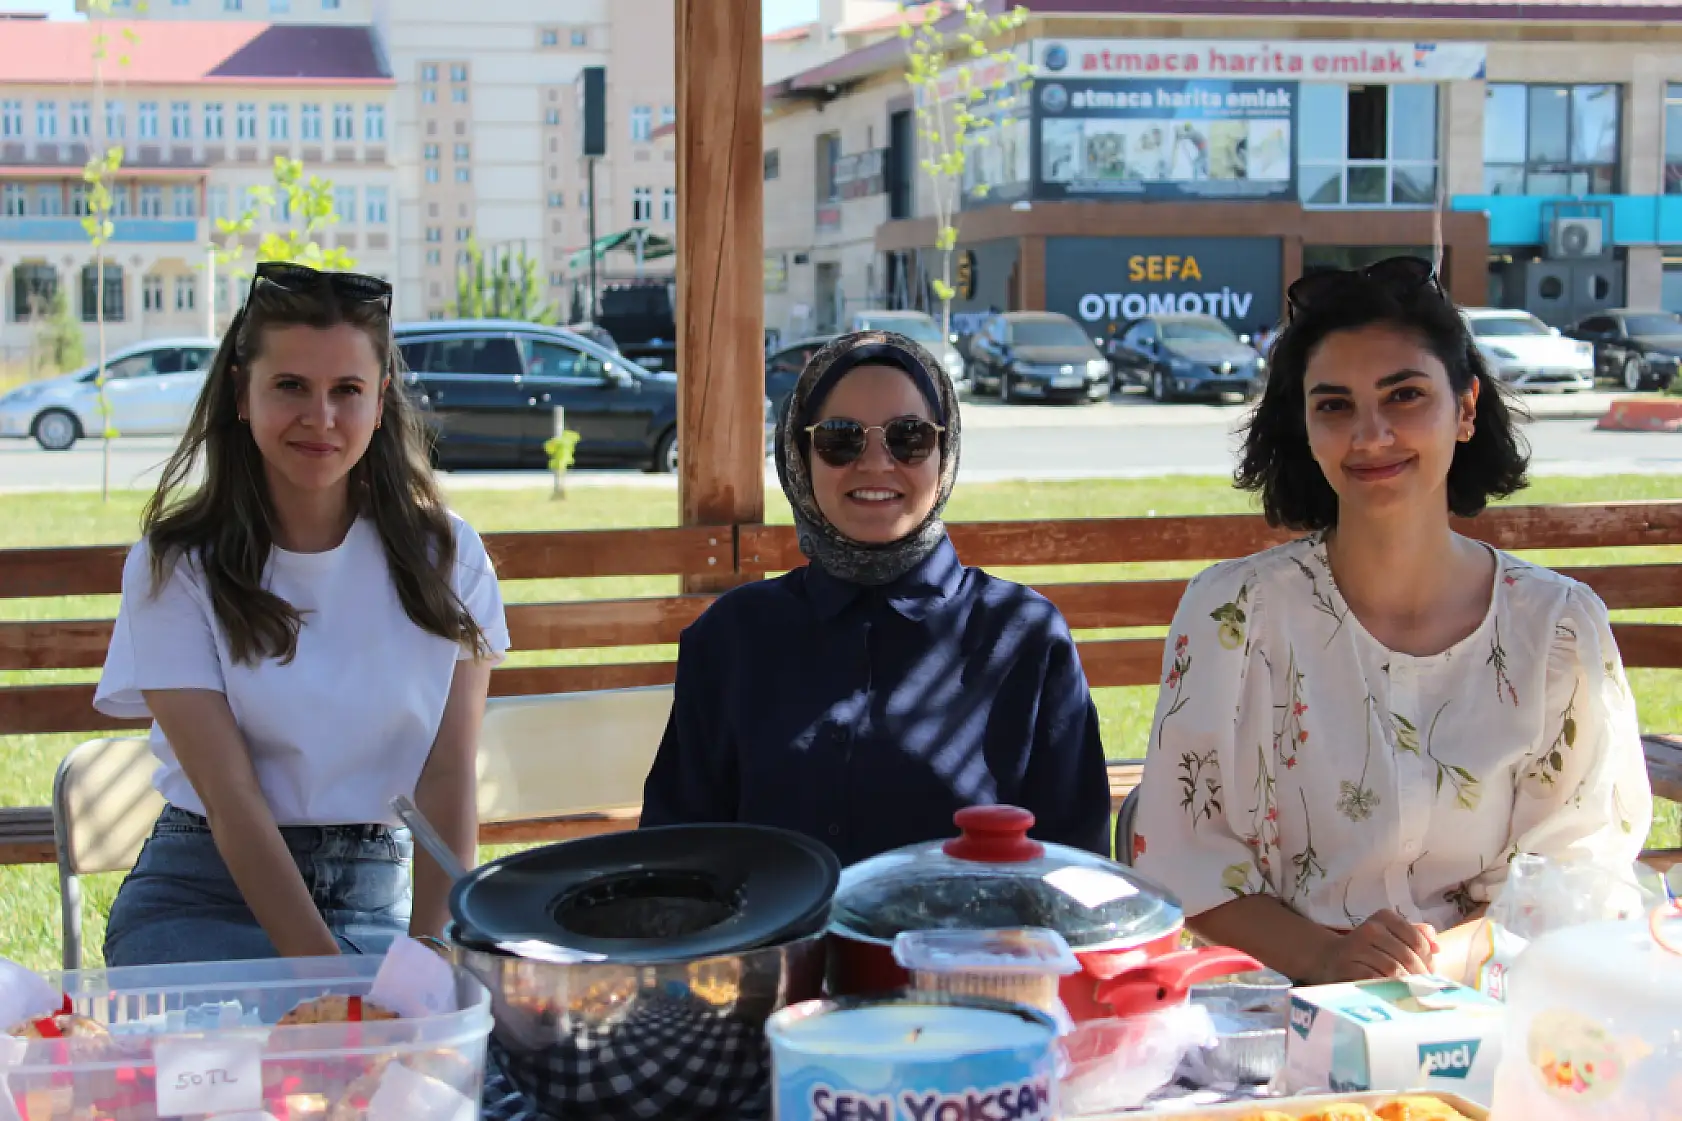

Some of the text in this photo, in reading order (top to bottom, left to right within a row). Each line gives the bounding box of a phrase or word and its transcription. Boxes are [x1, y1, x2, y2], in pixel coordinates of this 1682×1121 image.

[1081, 44, 1405, 73] atmaca harita emlak
[1071, 87, 1292, 109] atmaca harita emlak
[1128, 255, 1202, 281] SEFA
[1079, 286, 1253, 321] OTOMOTİV
[813, 1089, 888, 1121] SEN
